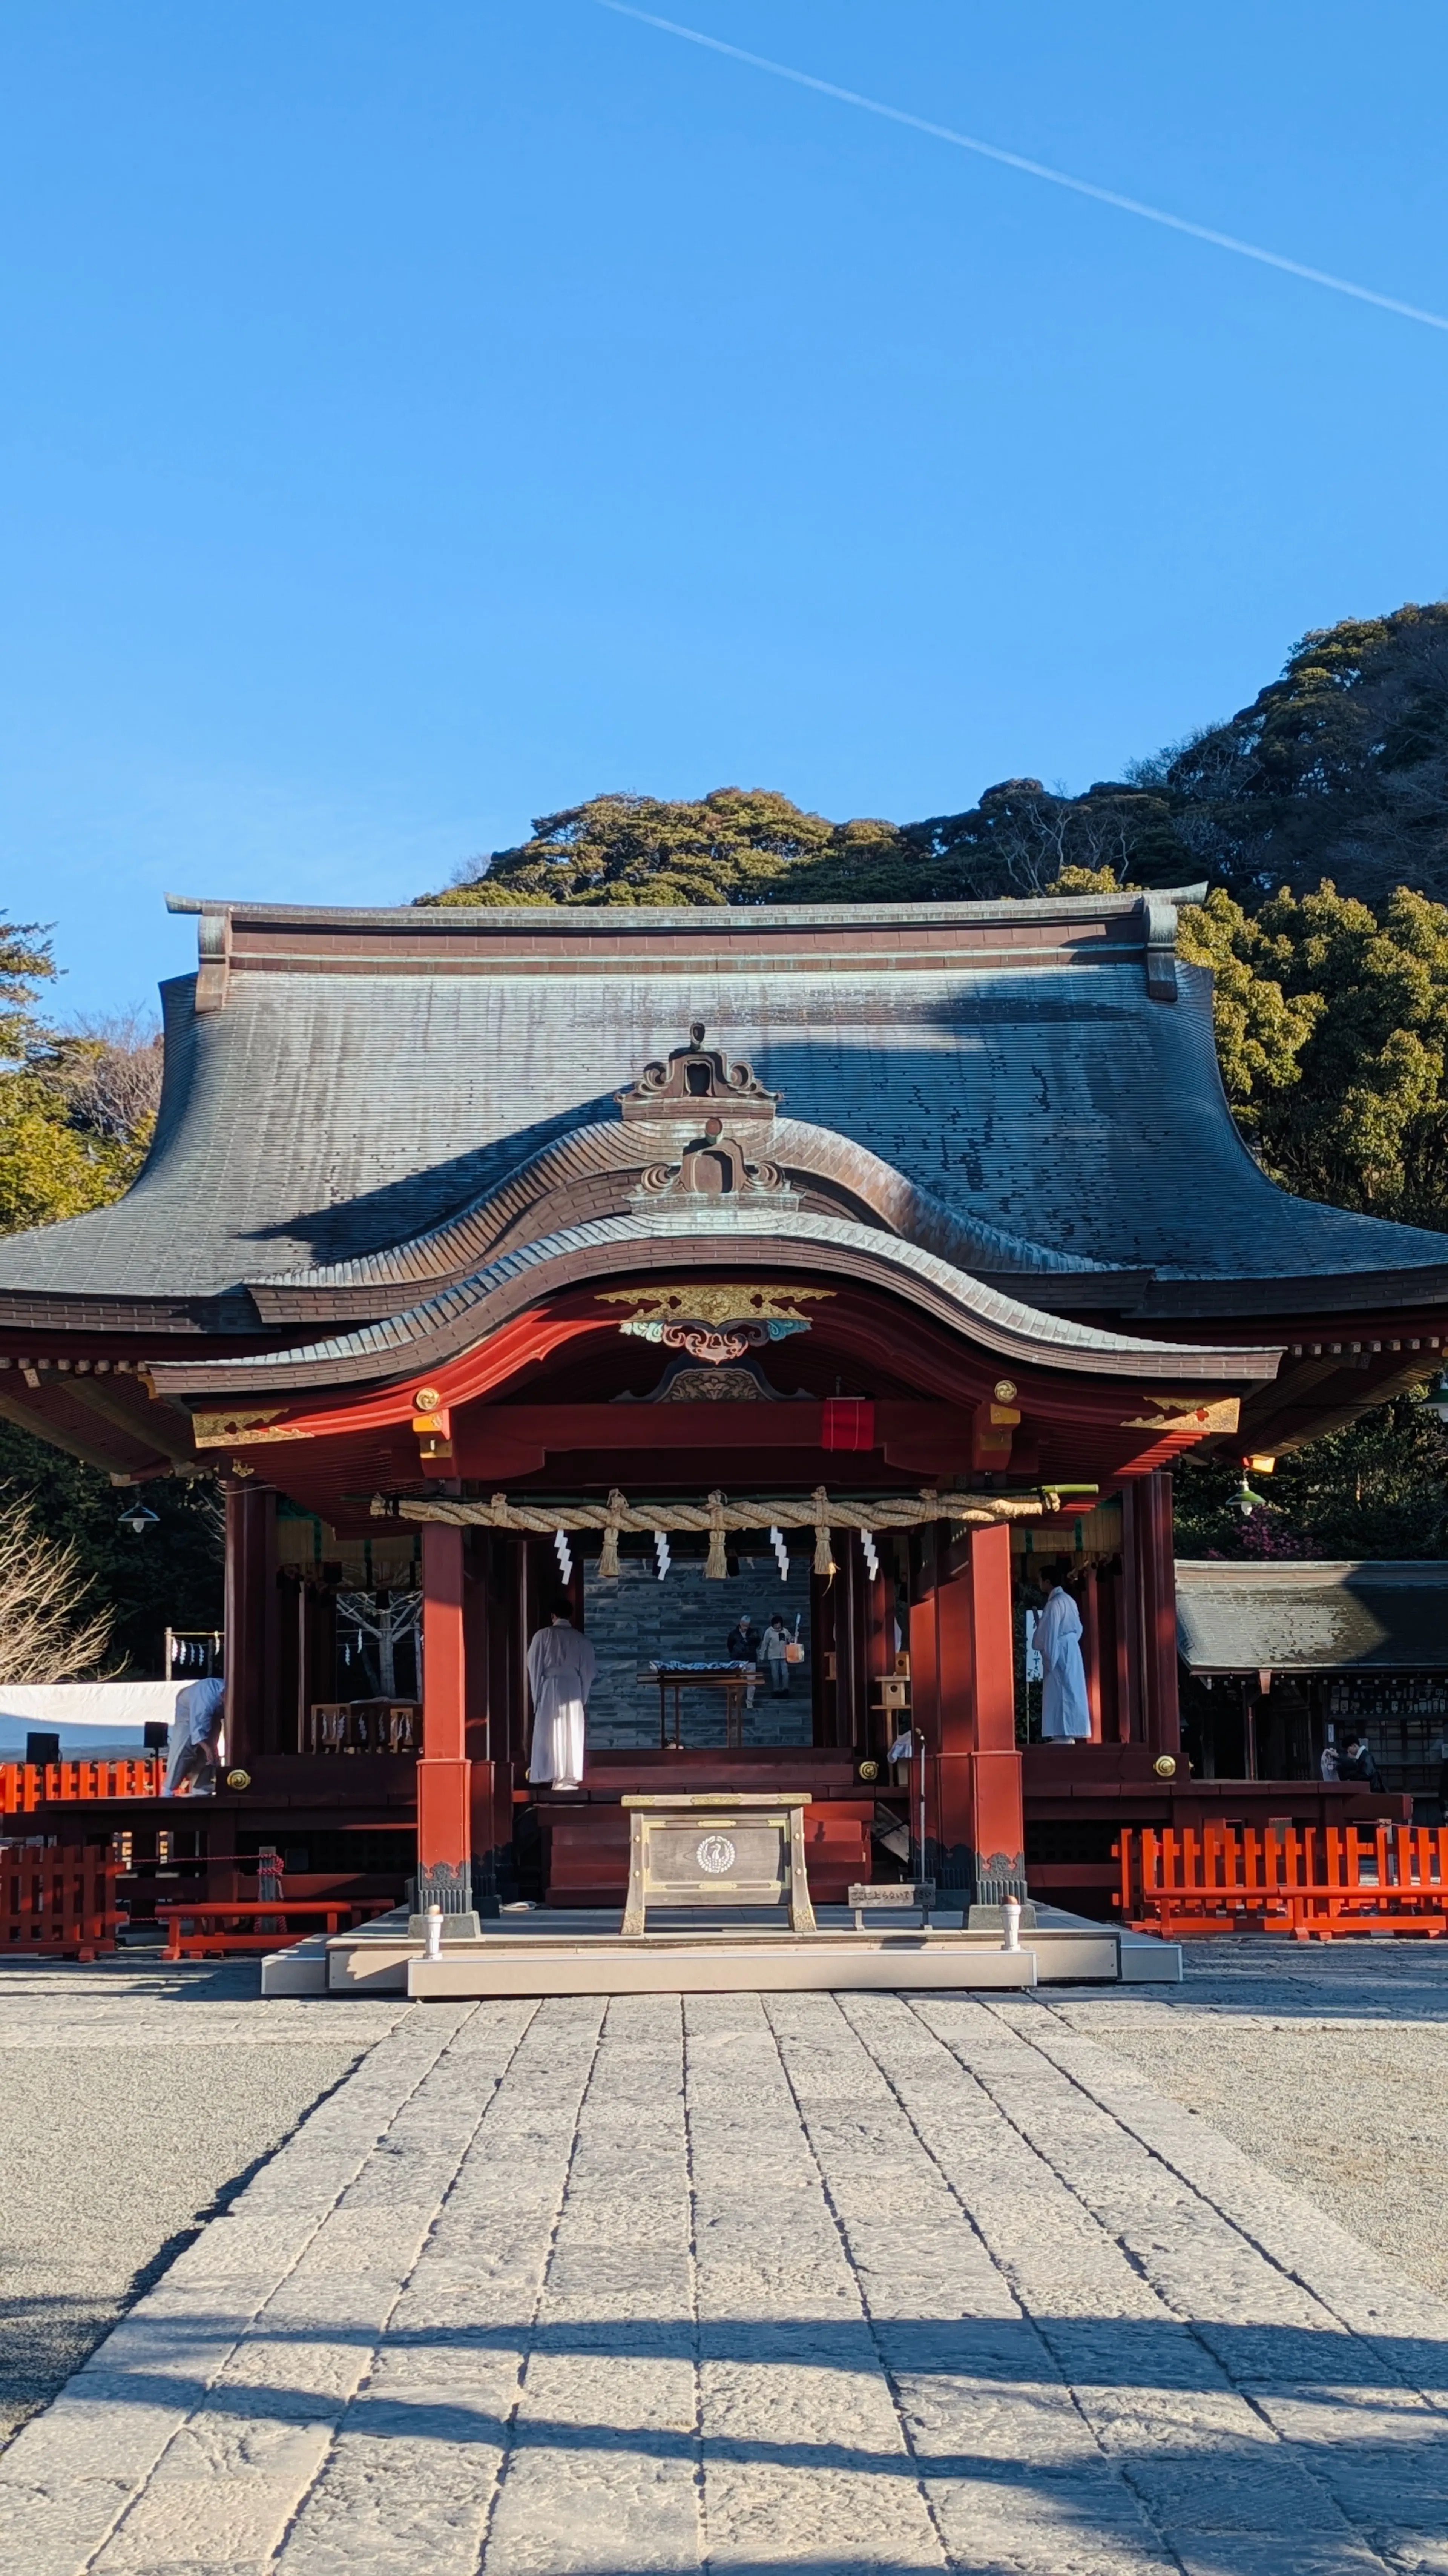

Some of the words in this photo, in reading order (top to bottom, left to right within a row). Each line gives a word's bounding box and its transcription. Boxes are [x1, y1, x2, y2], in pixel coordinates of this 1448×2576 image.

[851, 1891, 931, 1901] ここに上らないで下さい
